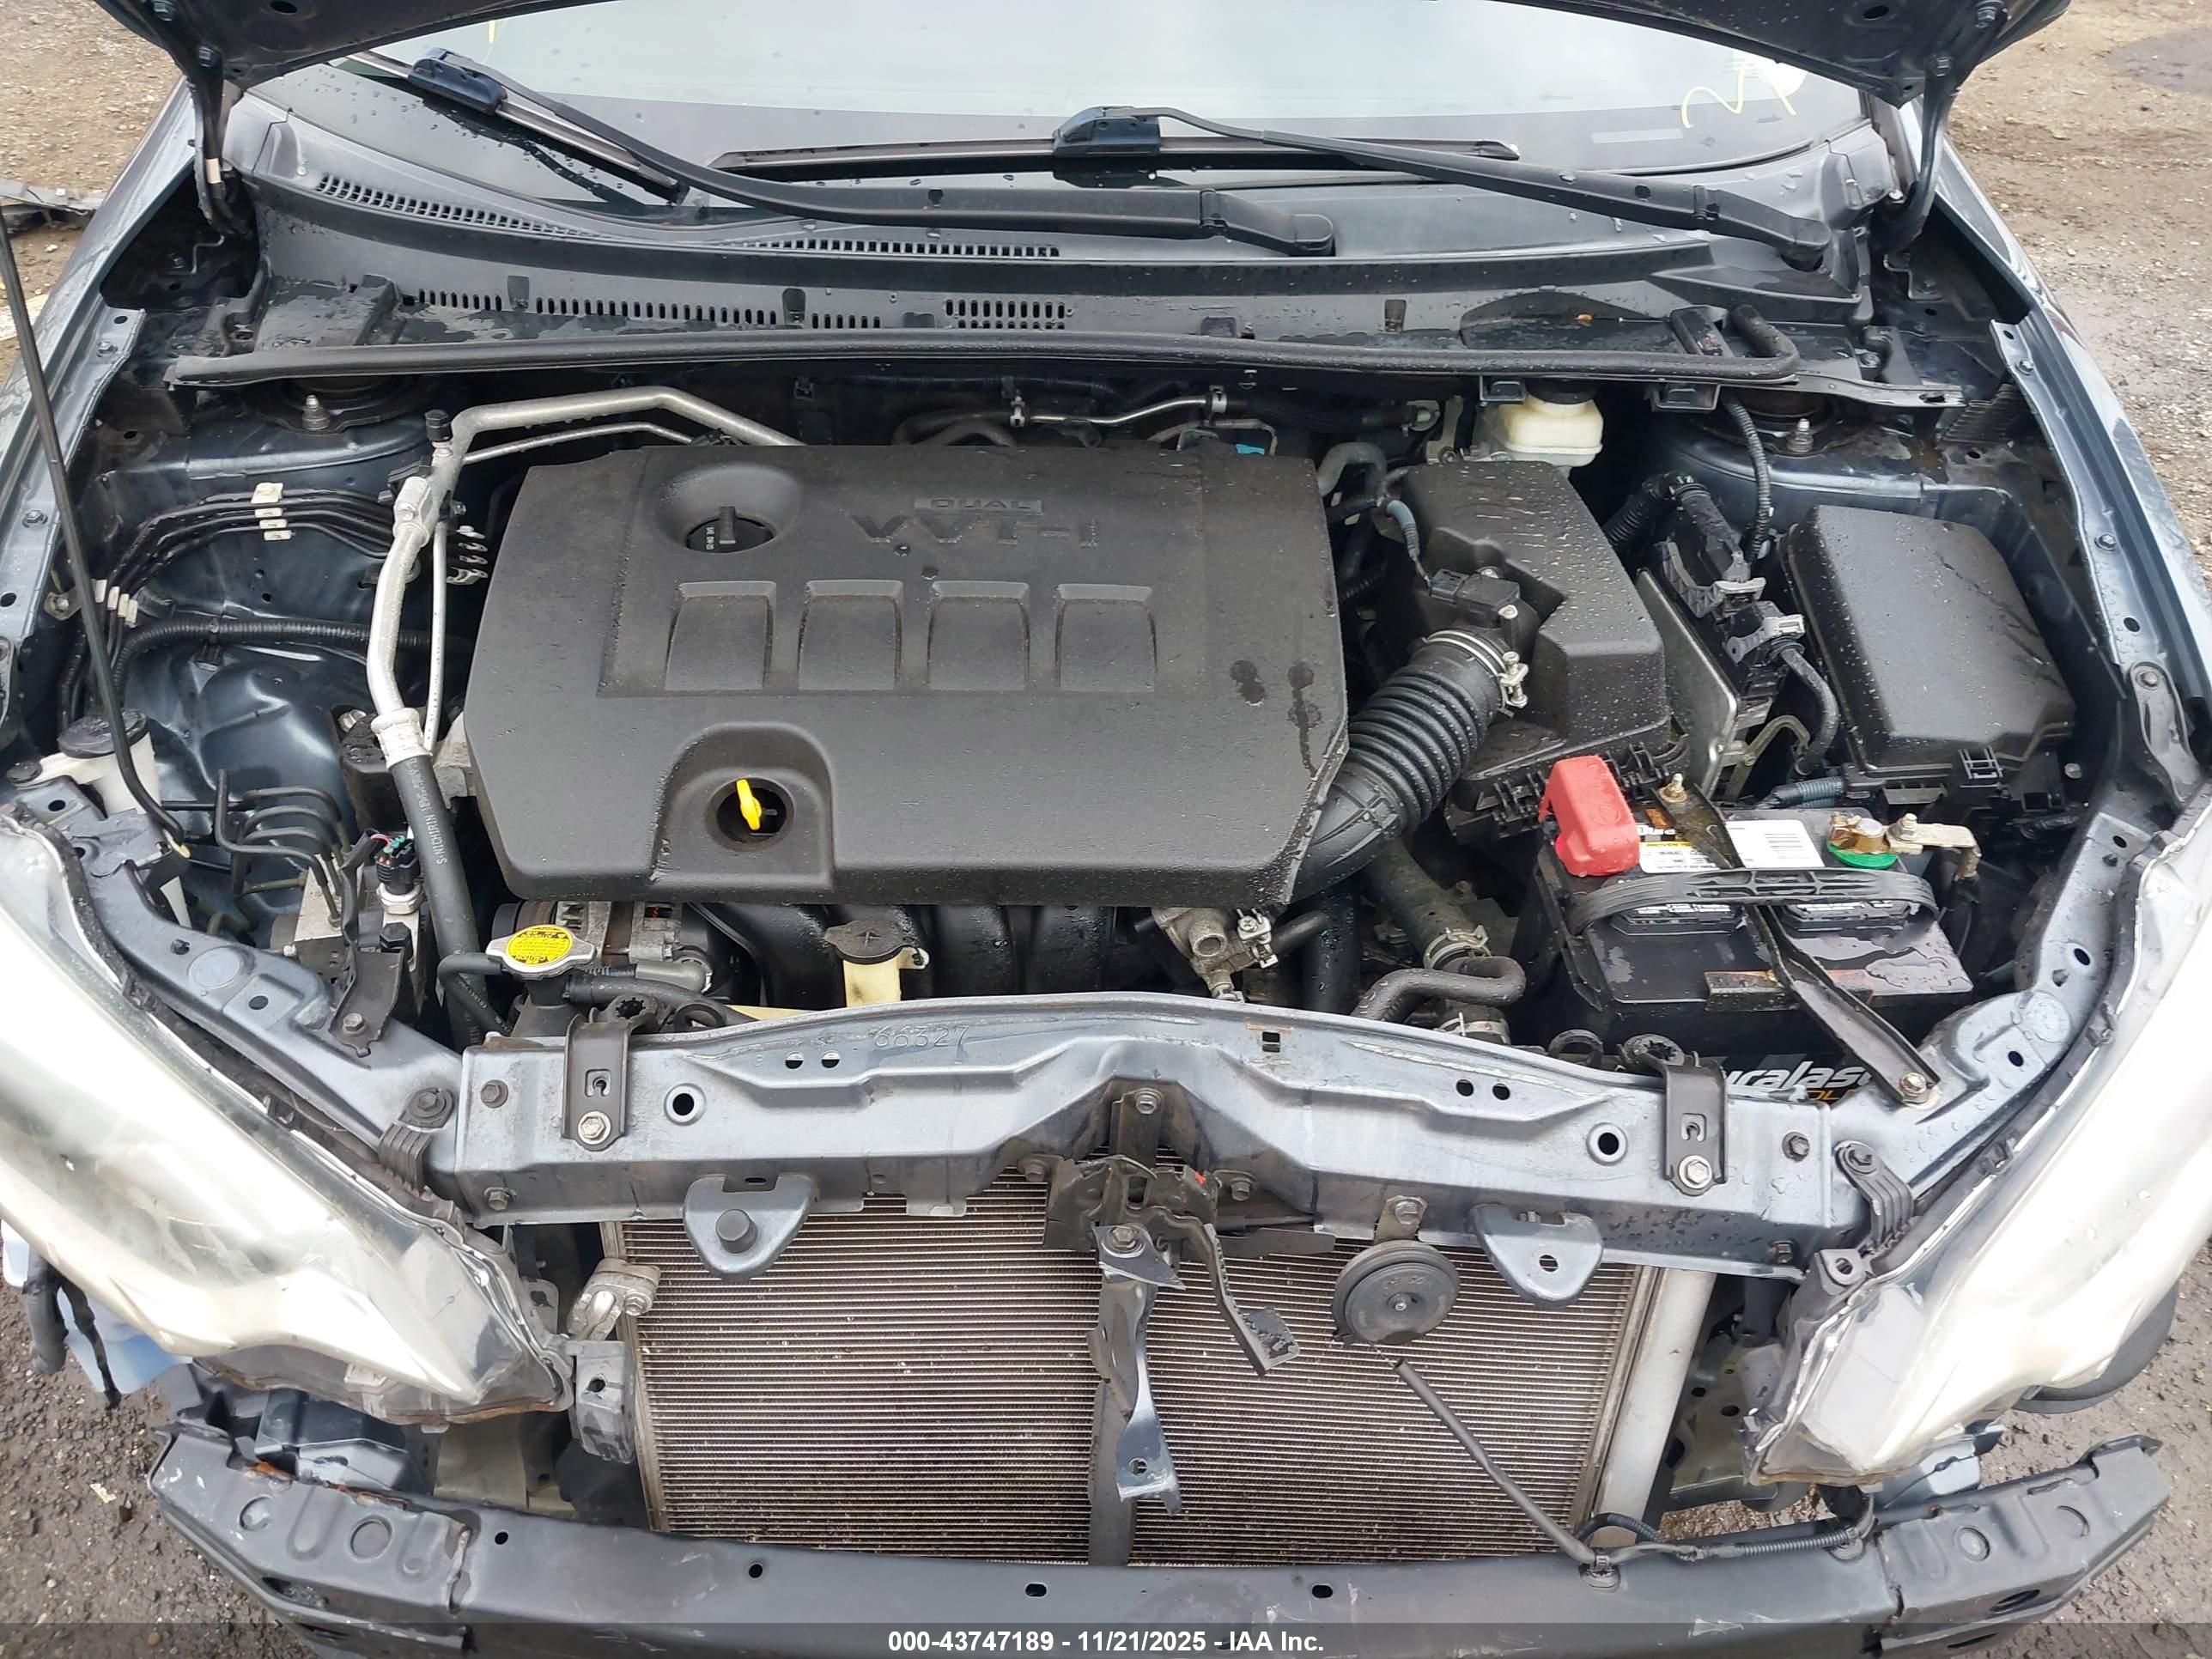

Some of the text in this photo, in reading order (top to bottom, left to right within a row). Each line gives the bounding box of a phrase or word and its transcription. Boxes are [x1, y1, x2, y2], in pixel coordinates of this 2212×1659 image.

[930, 498, 1032, 510] DUAL
[872, 1024, 970, 1048] 66327
[1721, 1060, 1873, 1089] uralas
